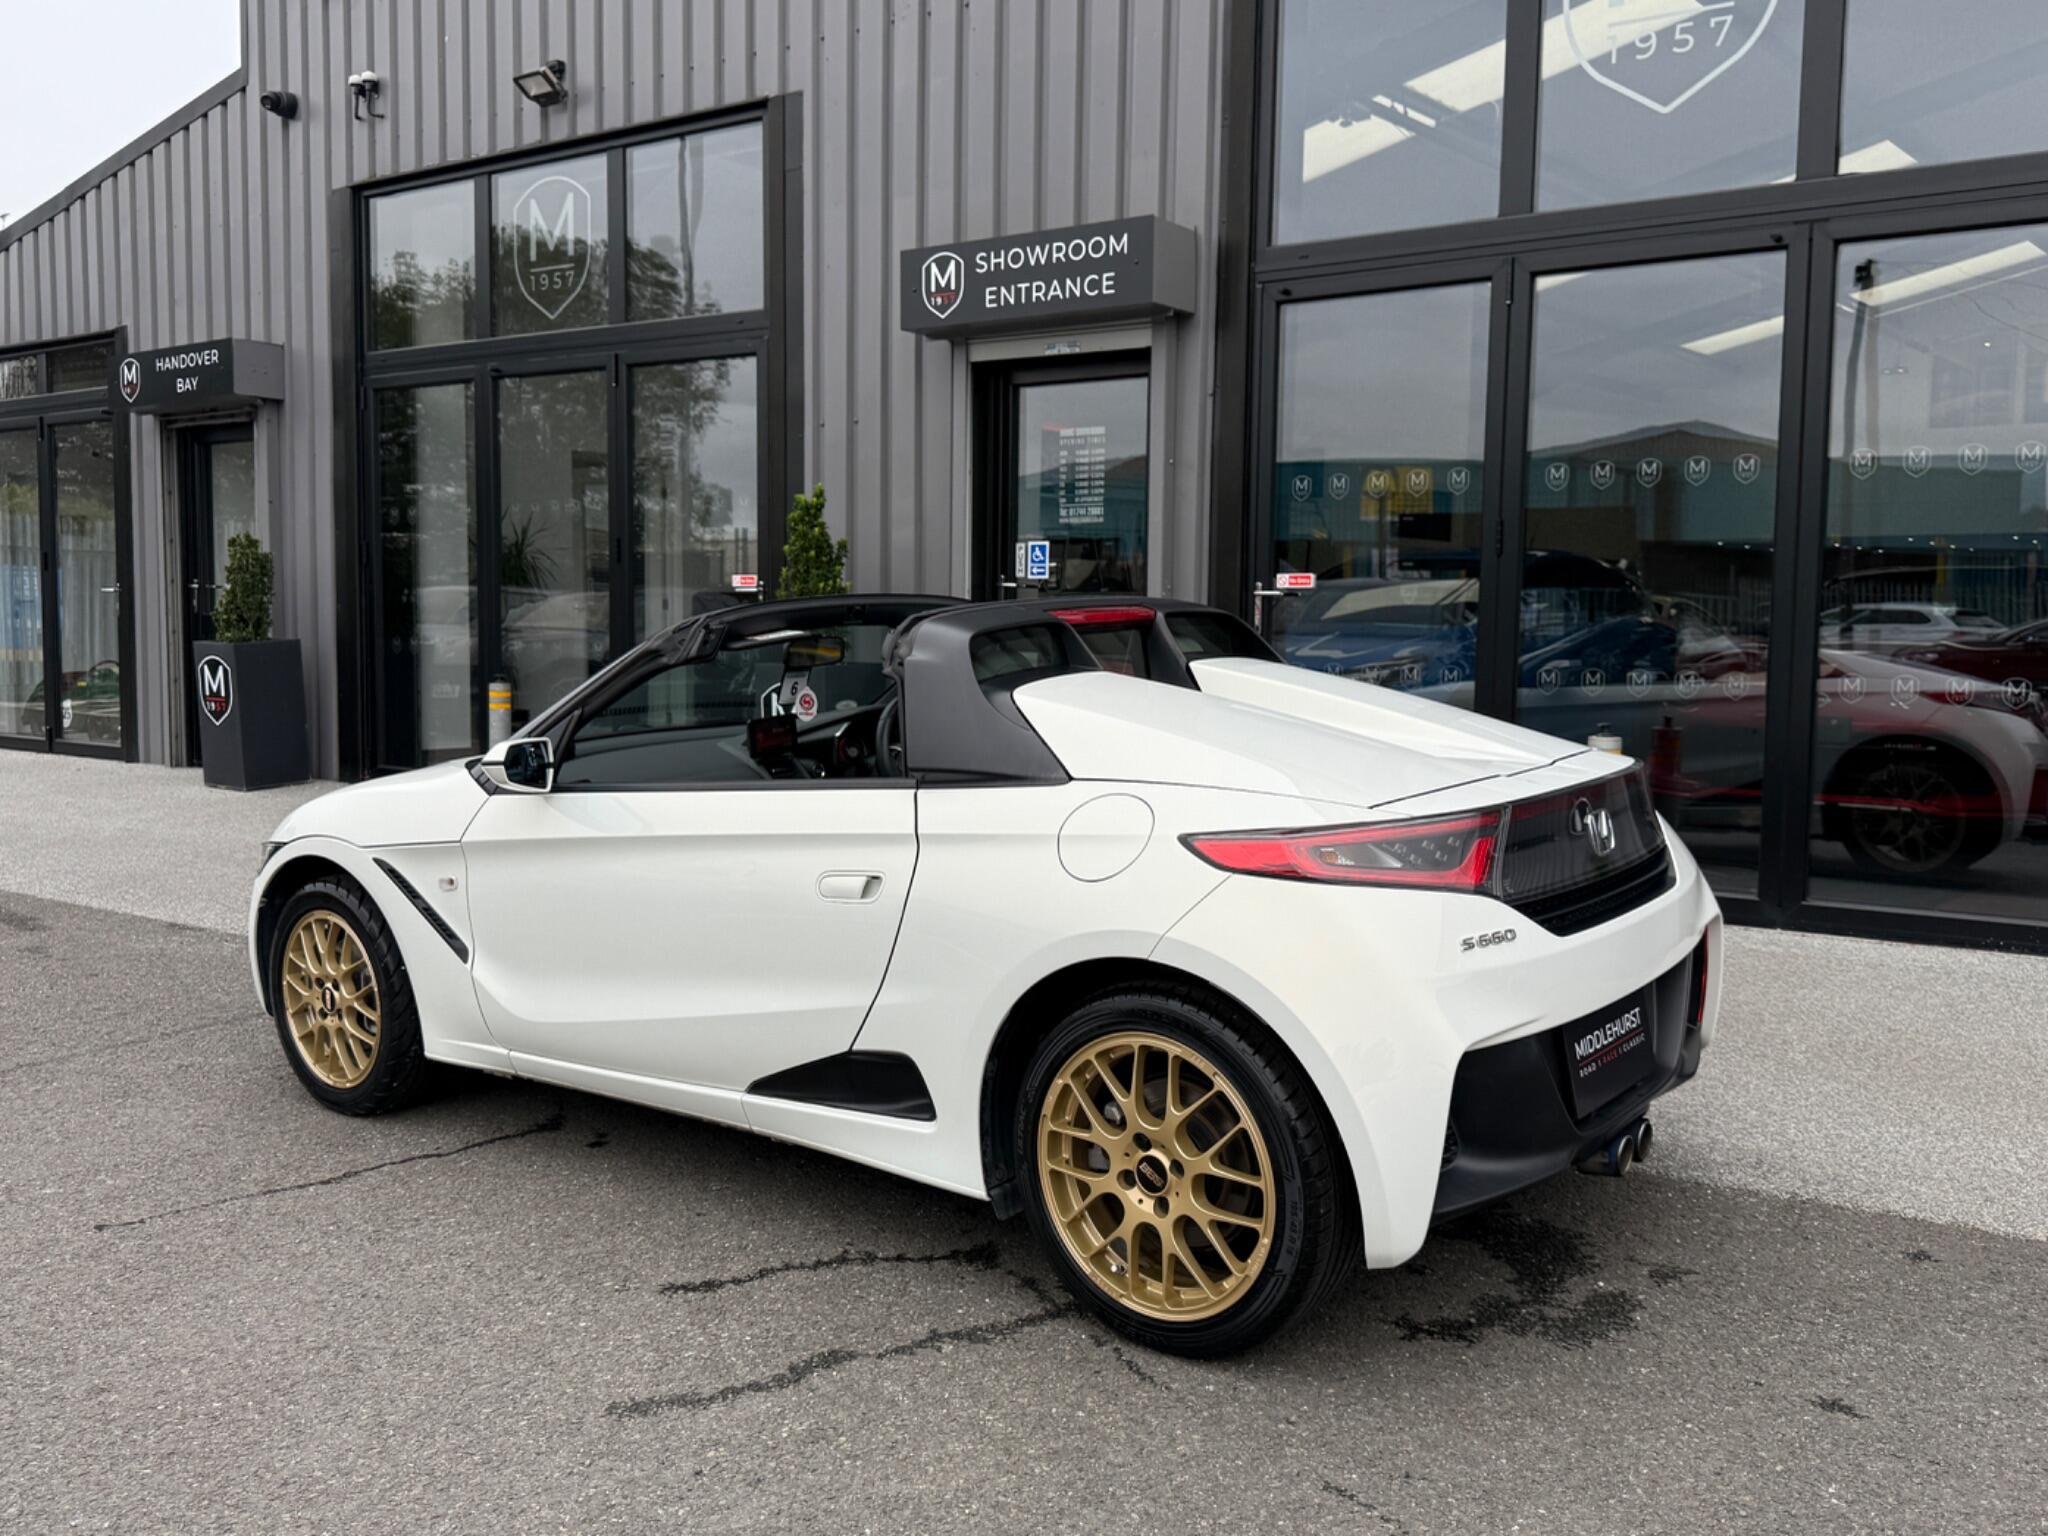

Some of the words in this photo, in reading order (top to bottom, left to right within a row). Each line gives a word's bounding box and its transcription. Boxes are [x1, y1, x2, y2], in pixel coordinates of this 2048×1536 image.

[529, 190, 575, 262] M
[974, 232, 1129, 274] SHOWROOM
[529, 270, 576, 292] 1957
[930, 259, 956, 293] M
[984, 271, 1117, 309] ENTRANCE
[155, 349, 220, 373] HANDOVER
[175, 376, 199, 394] BAY
[203, 664, 226, 697] M
[791, 681, 799, 696] 6
[1460, 928, 1517, 953] S660
[1574, 1006, 1641, 1060] MIDDLEHURST
[1579, 1062, 1597, 1078] ROAD
[1623, 1032, 1646, 1052] CLASSIC
